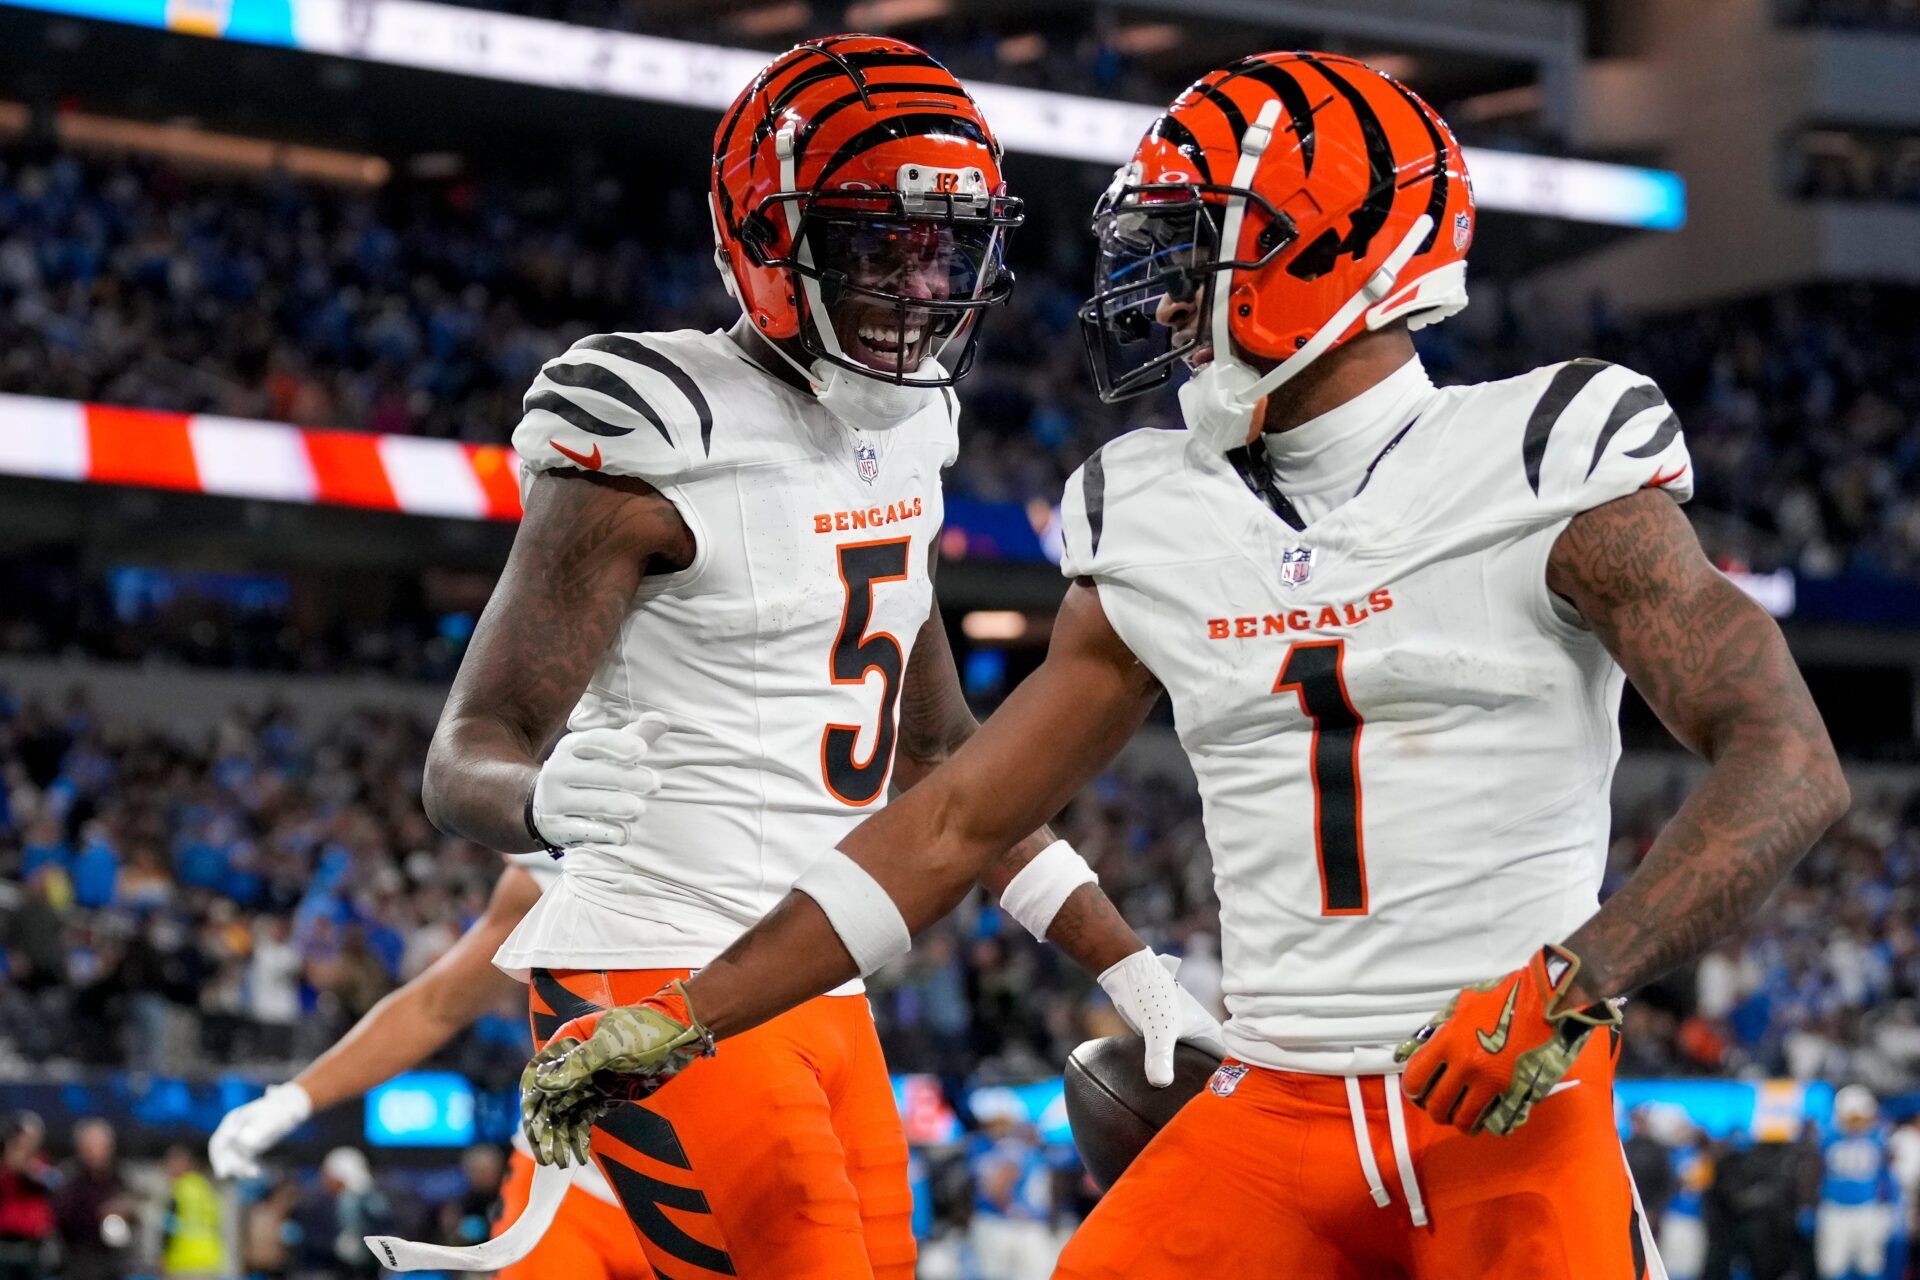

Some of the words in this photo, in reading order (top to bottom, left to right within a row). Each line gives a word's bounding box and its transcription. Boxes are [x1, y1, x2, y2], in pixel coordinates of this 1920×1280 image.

[813, 497, 922, 533] BENGALS
[820, 535, 911, 807] 5
[1207, 589, 1394, 639] BENGALS
[1271, 639, 1368, 916] 1
